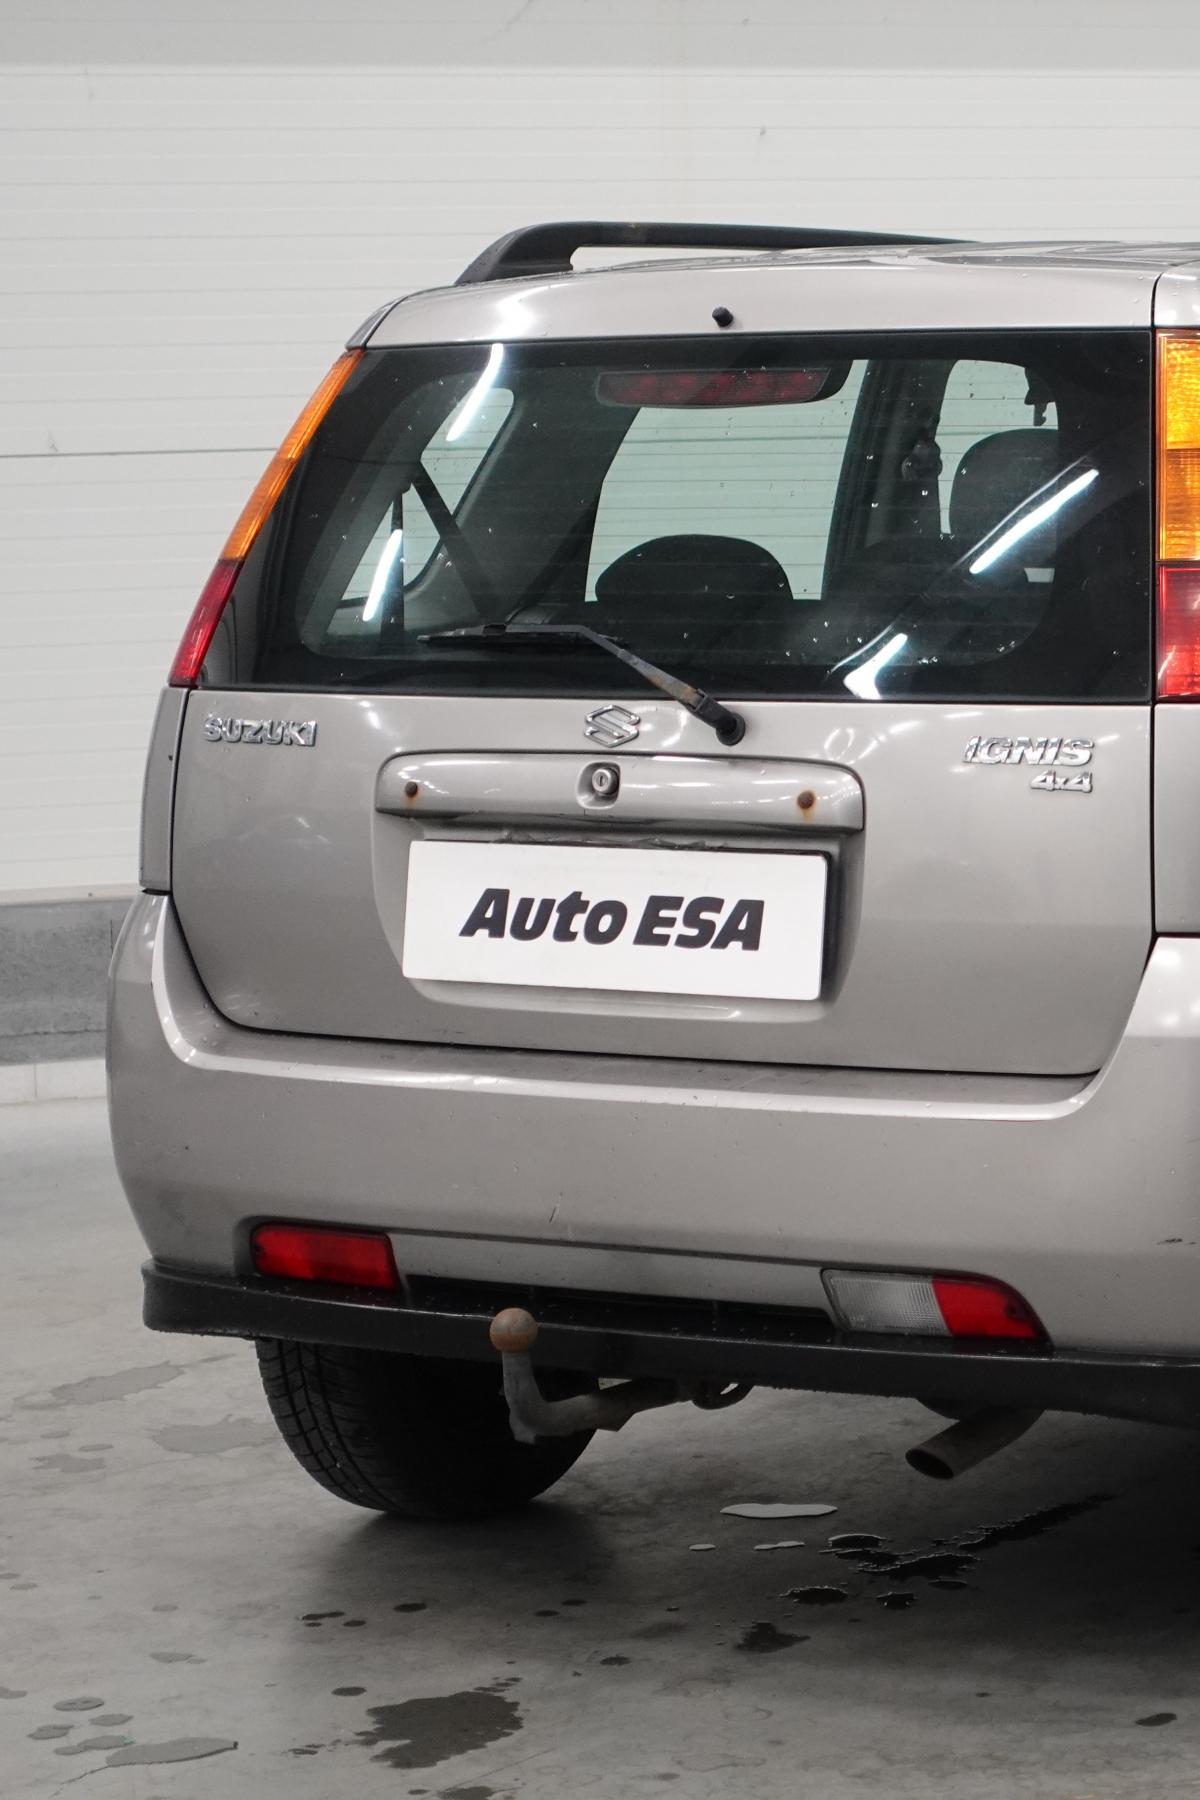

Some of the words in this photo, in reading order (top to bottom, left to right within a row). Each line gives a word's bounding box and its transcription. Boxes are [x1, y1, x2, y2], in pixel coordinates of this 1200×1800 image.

[204, 715, 316, 747] SUZUKI
[963, 735, 1094, 766] IGNIS
[459, 888, 627, 946] Auto
[632, 895, 765, 951] ESA
